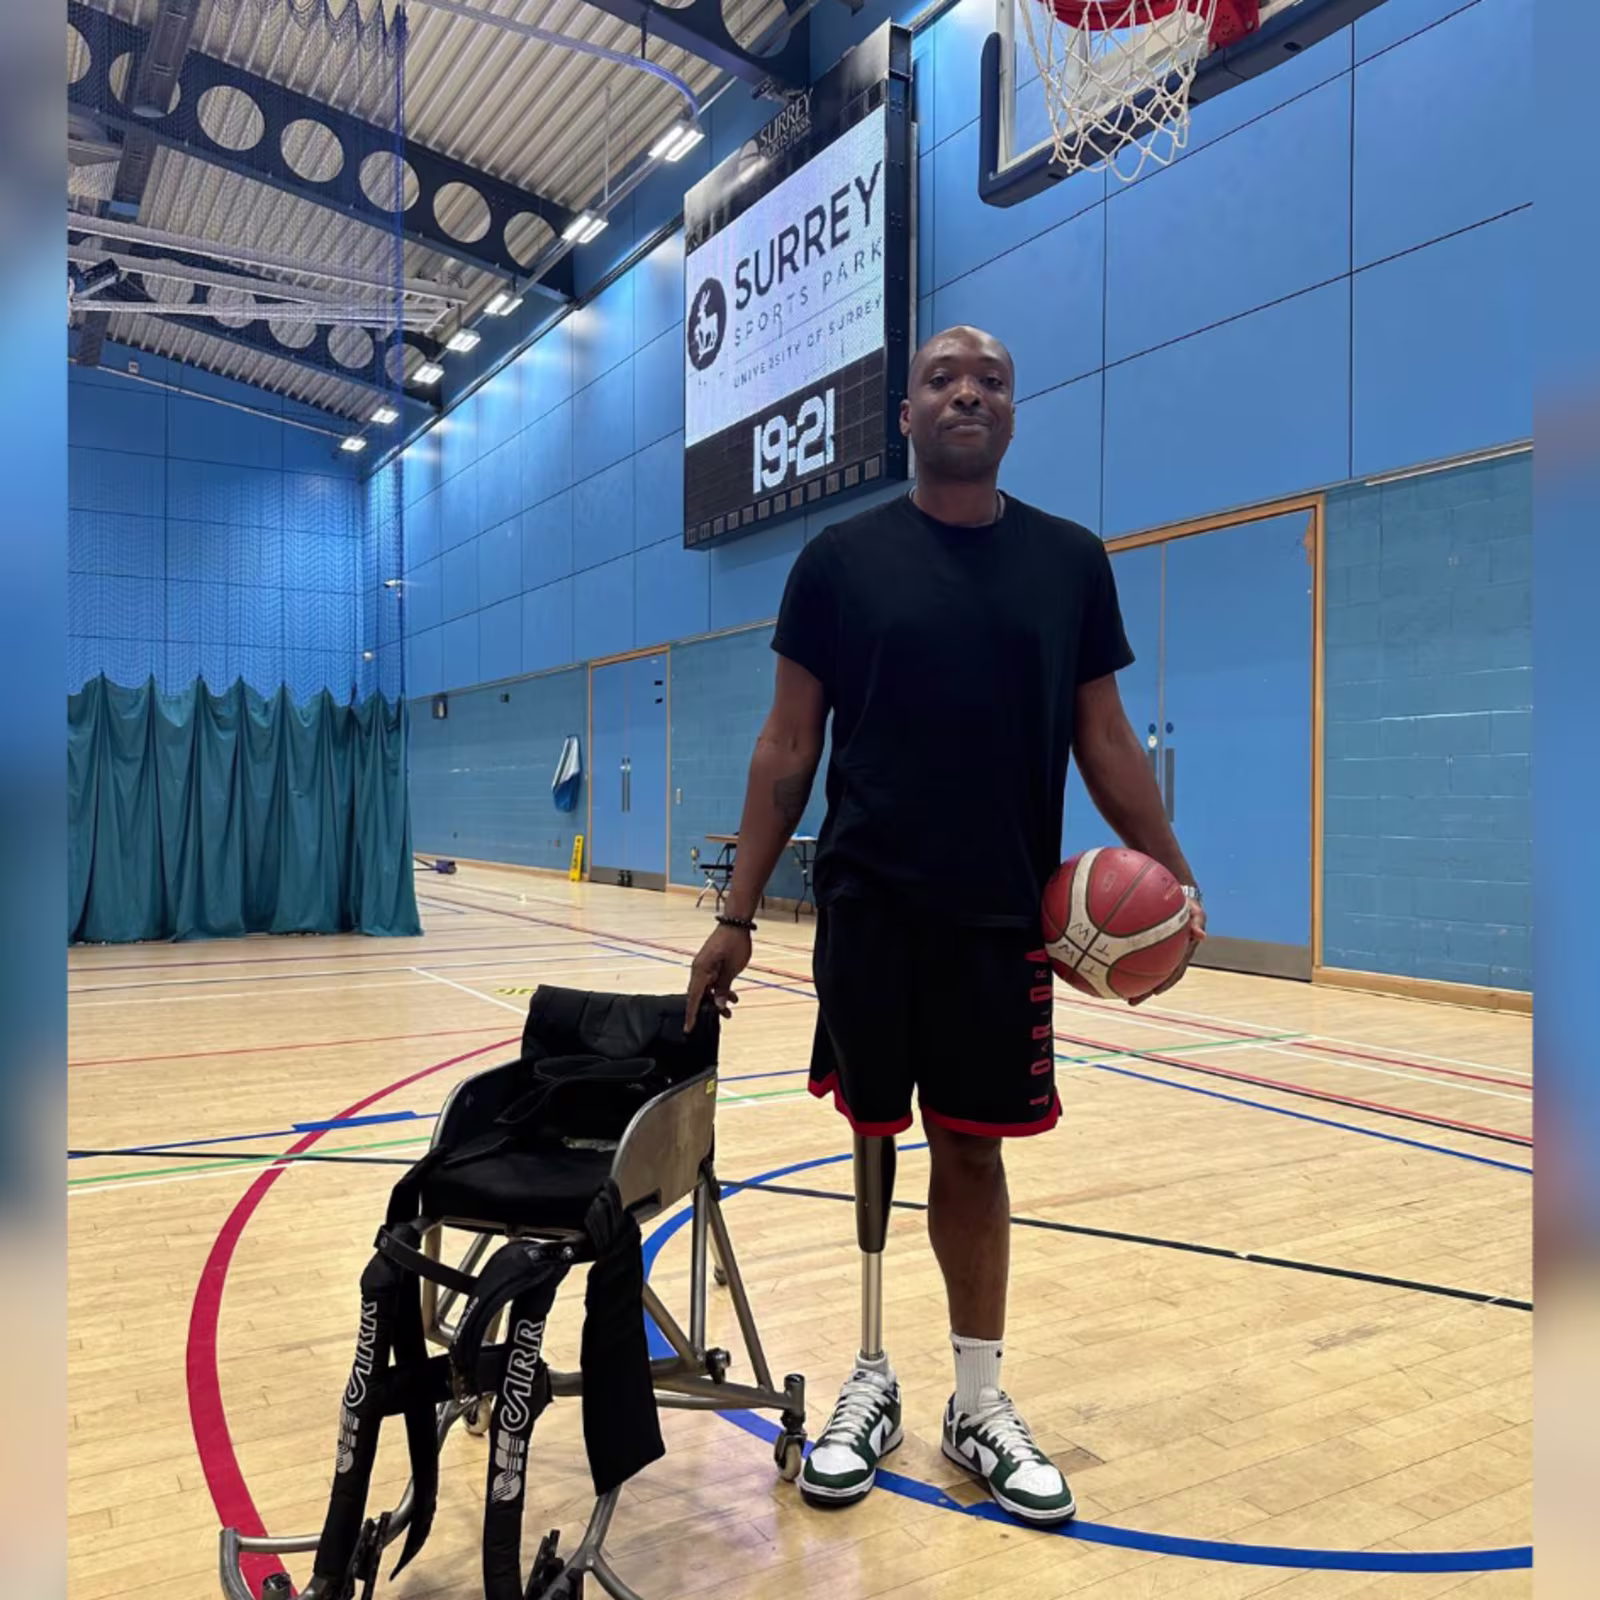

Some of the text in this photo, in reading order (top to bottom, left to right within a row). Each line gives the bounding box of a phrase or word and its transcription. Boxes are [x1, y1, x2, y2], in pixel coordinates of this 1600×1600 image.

[760, 87, 814, 151] SURREY
[735, 160, 883, 310] SURREY
[733, 293, 883, 388] UNIVERSITY OF SURREY
[734, 237, 882, 348] SPORTS PARK
[753, 388, 835, 494] 19:21
